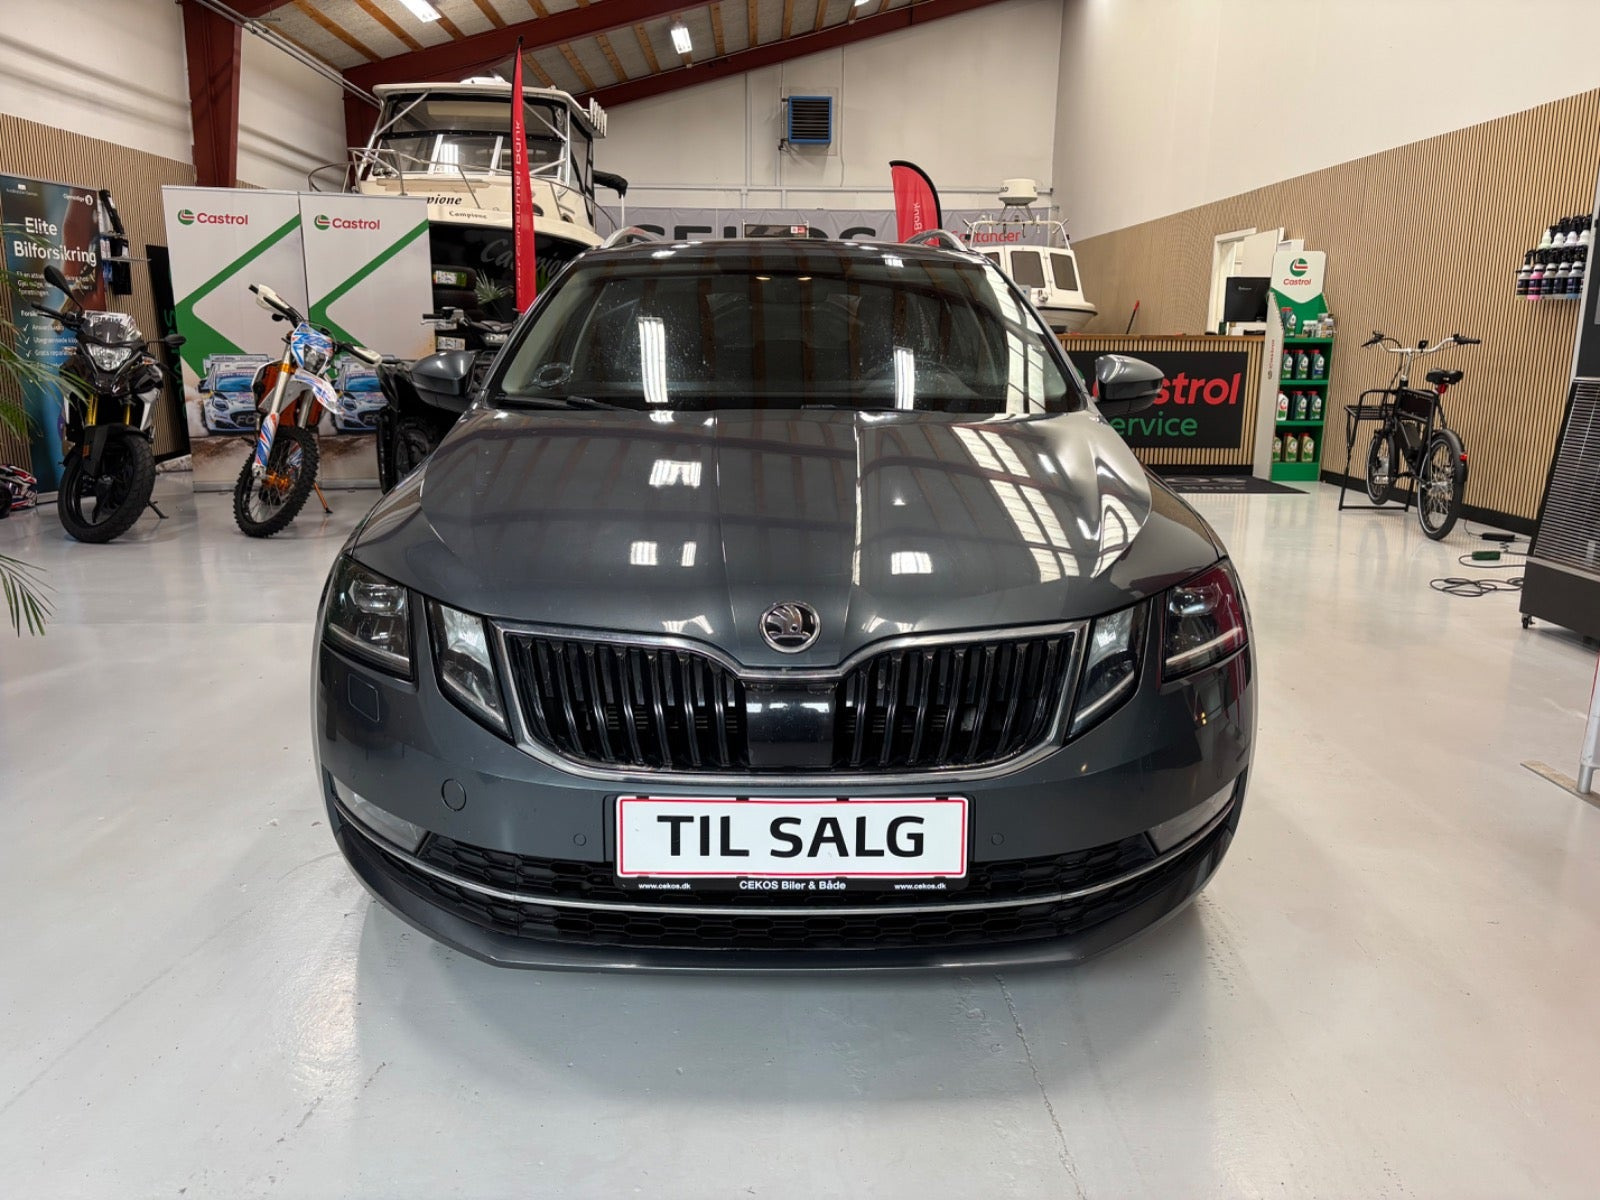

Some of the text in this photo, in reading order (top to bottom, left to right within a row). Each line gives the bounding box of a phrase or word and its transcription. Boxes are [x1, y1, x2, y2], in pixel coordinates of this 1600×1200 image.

[427, 194, 462, 205] pione
[197, 212, 249, 226] Castrol
[449, 210, 487, 220] Campione
[25, 217, 58, 236] Elite
[332, 217, 380, 230] Castrol
[13, 240, 97, 268] Bilforsikring
[1283, 278, 1312, 286] Castrol
[1092, 372, 1242, 405] strol
[1109, 411, 1199, 437] ervice
[657, 815, 925, 858] TIL SALG
[739, 880, 846, 890] CEKOS Biler & Både
